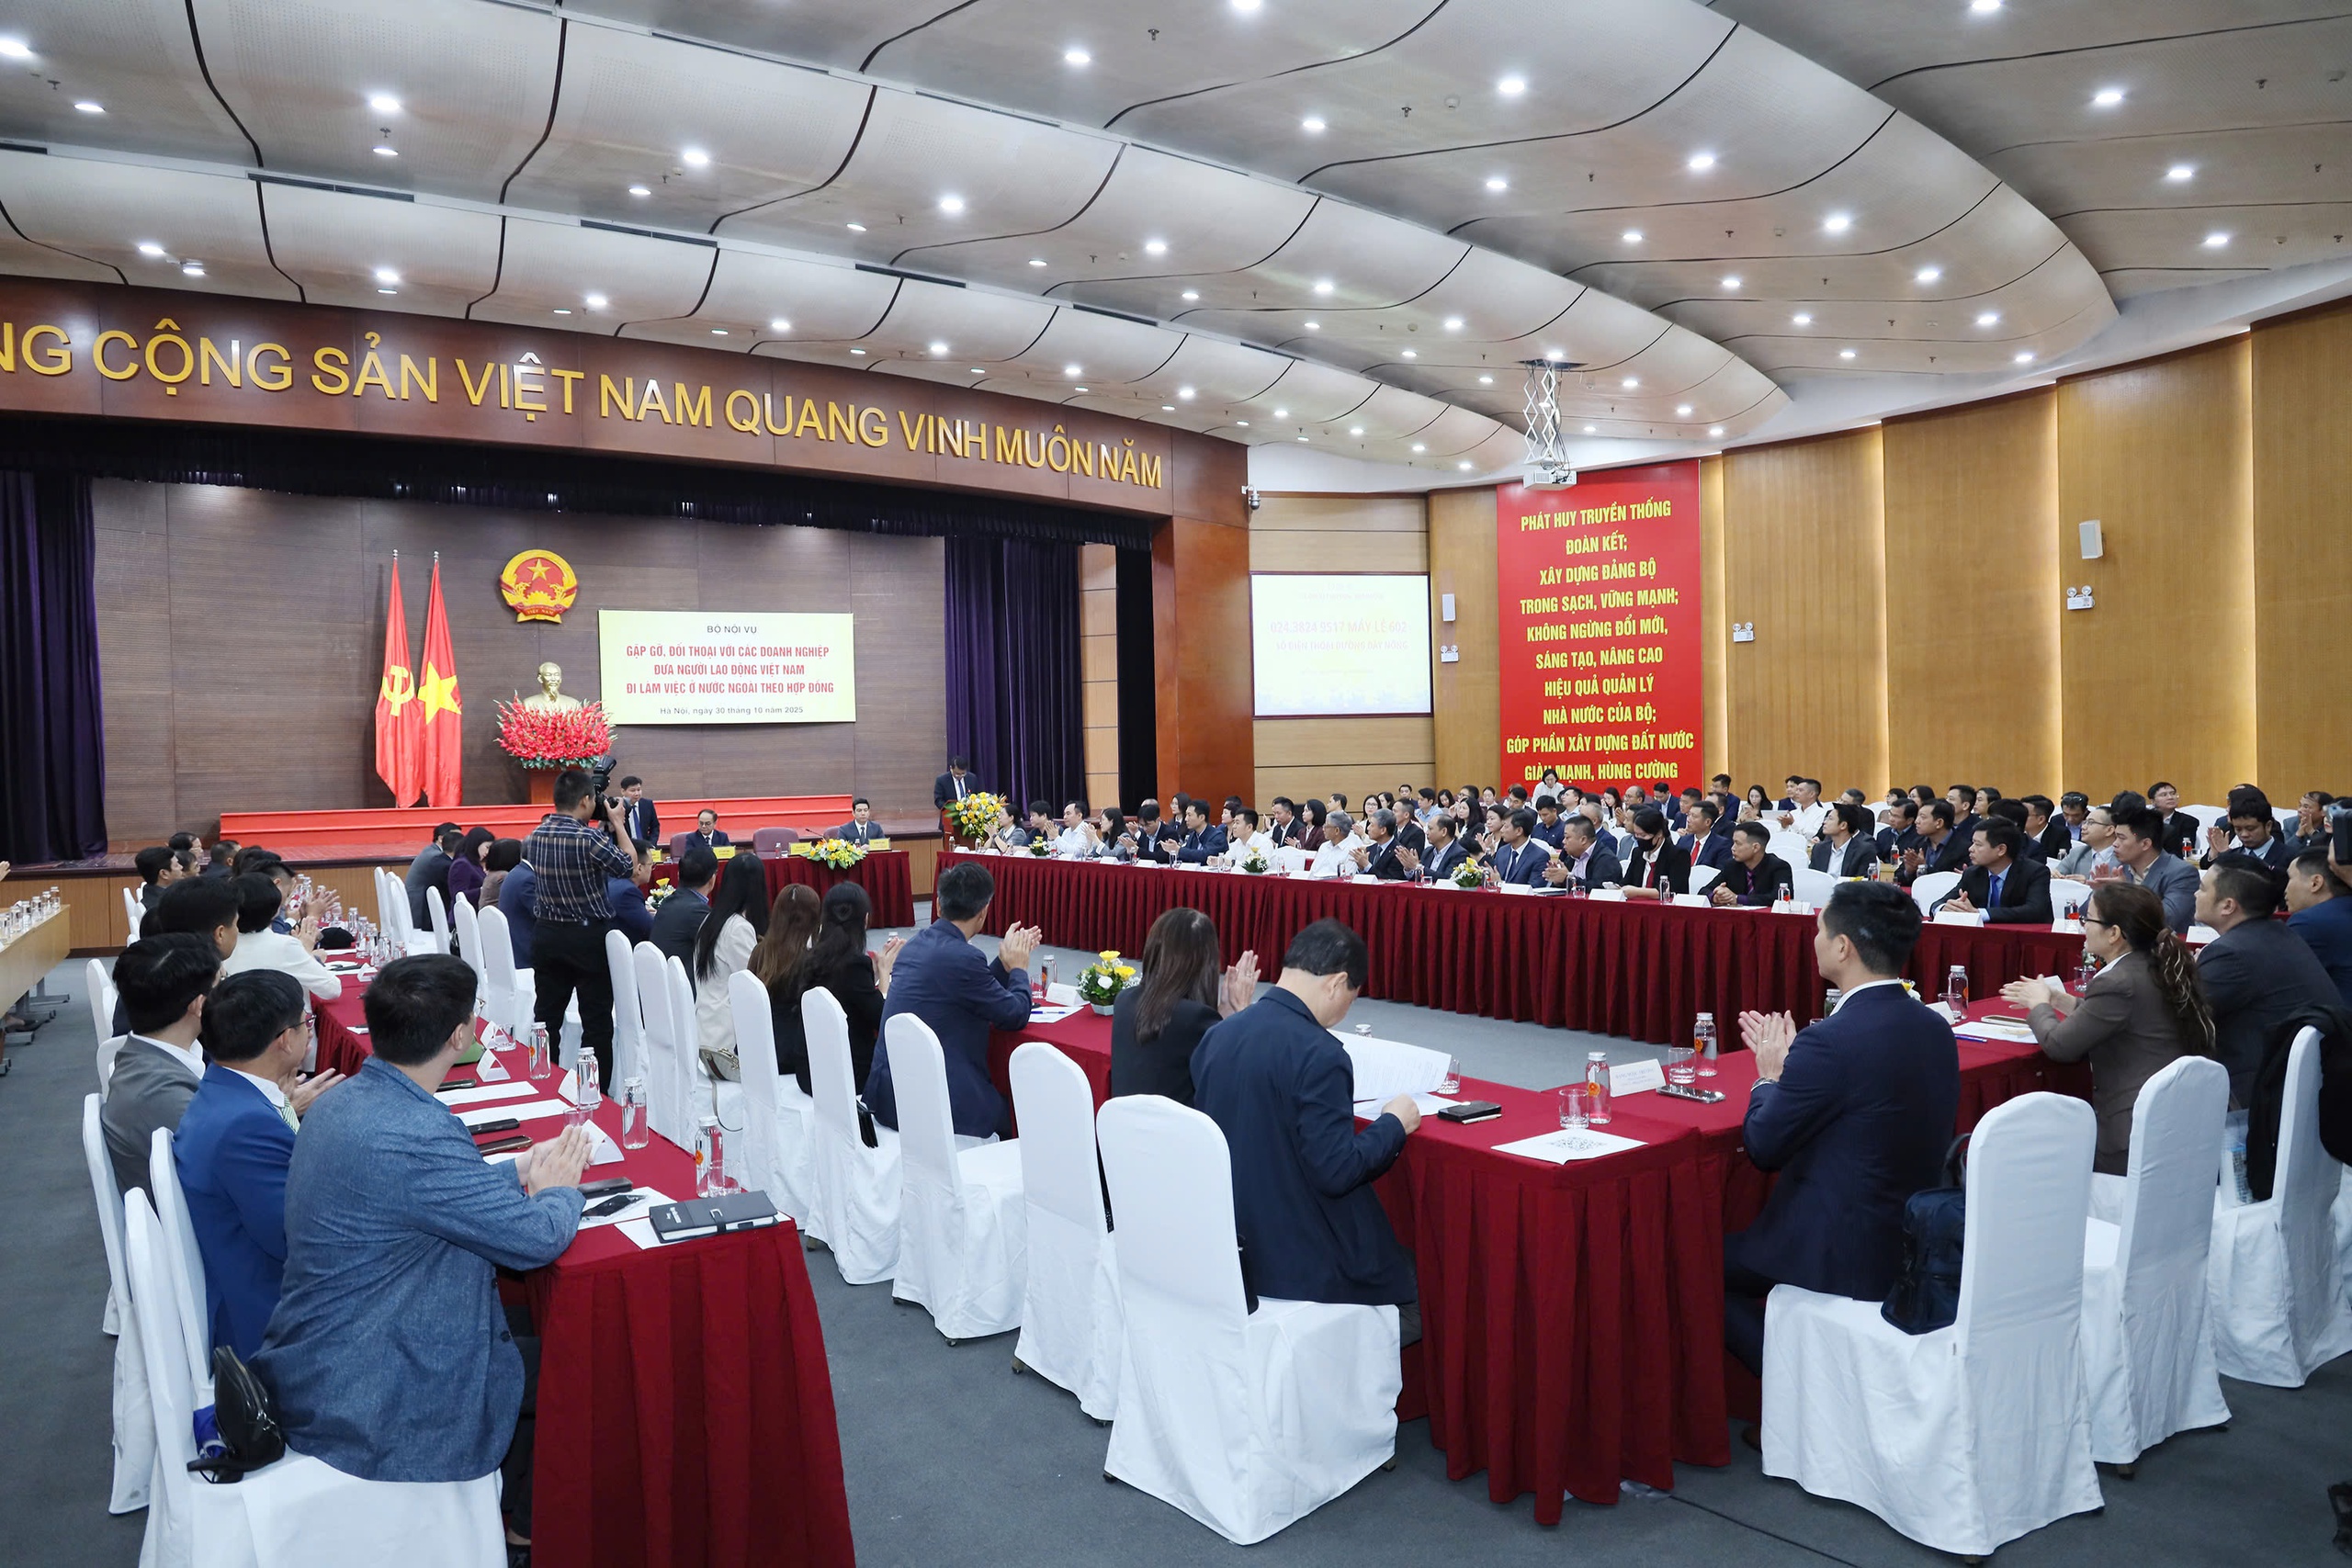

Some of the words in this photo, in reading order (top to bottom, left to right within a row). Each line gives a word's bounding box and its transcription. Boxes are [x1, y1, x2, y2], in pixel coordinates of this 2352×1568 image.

[93, 319, 292, 395] CỘNG
[311, 332, 438, 402] SẢN
[456, 352, 584, 422] VIỆT
[600, 375, 713, 428] NAM
[725, 389, 888, 448] QUANG
[899, 410, 987, 460] VINH
[995, 424, 1092, 478] MUÔN
[1098, 438, 1162, 489] NĂM
[1521, 511, 1552, 532] PHÁT
[1554, 510, 1577, 529] HUY
[1579, 501, 1627, 525] TRUYỀN
[1629, 496, 1672, 520] THỐNG
[1566, 535, 1600, 556] ĐOÀN
[1601, 529, 1629, 553] KẾT;
[1539, 566, 1563, 586] XÂY
[1565, 564, 1600, 587] DỰNG
[1601, 558, 1636, 581] ĐẢNG
[1639, 557, 1657, 581] BỘ
[1520, 596, 1559, 615] TRONG
[1561, 592, 1598, 615] SẠCH,
[1600, 589, 1634, 609] VỮNG
[1636, 587, 1679, 610] MẠNH;
[707, 624, 721, 635] BỘ
[724, 624, 741, 635] NỘI
[744, 626, 757, 636] VỤ
[1526, 621, 1567, 643] KHÔNG
[1569, 618, 1612, 640] NGỪNG
[1614, 613, 1636, 637] ĐỔI
[1639, 614, 1669, 637] MỚI,
[627, 644, 647, 660] GẶP
[650, 643, 666, 658] GỠ,
[669, 642, 685, 657] ĐỐI
[688, 646, 717, 660] THOẠI
[719, 644, 735, 657] VỚI
[738, 644, 757, 658] CÁC
[760, 646, 793, 658] DOANH
[795, 644, 830, 660] NGHIỆP
[1534, 648, 1568, 670] SÁNG
[1570, 650, 1598, 671] TẠO,
[1600, 646, 1635, 666] NÂNG
[1638, 646, 1664, 664] CAO
[653, 663, 674, 675] ĐƯA
[677, 661, 707, 675] NGƯỜI
[710, 664, 729, 675] LAO
[730, 662, 758, 677] ĐỘNG
[760, 662, 780, 677] VIỆT
[782, 664, 805, 675] NAM
[626, 682, 637, 694] ĐI
[639, 681, 662, 694] LÀM
[663, 681, 686, 696] VIỆC
[689, 679, 696, 694] Ở
[698, 681, 725, 694] NƯỚC
[728, 681, 758, 694] NGOÀI
[760, 682, 784, 694] THEO
[786, 682, 806, 695] HỢP
[808, 679, 834, 694] ĐỒNG
[1544, 677, 1573, 700] HIỆU
[1574, 673, 1600, 697] QUẢ
[1601, 671, 1636, 696] QUẢN
[1639, 672, 1655, 693] LÝ
[673, 707, 691, 716] Nội,
[693, 707, 713, 716] ngày
[715, 706, 726, 715] 30
[727, 706, 752, 716] tháng
[1543, 705, 1568, 725] NHÀ
[1570, 704, 1604, 725] NƯỚC
[1607, 700, 1634, 724] CỦA
[1635, 702, 1657, 726] BỘ;
[1506, 734, 1531, 754] GÓP
[1532, 731, 1566, 753] PHẦN
[1567, 733, 1592, 752] XÂY
[1594, 733, 1629, 755] DỰNG
[1631, 728, 1656, 751] ĐẤT
[1658, 729, 1695, 750] NƯỚC
[1524, 761, 1553, 782] GIÀ
[1555, 764, 1595, 784] MẠNH,
[1598, 760, 1632, 780] HÙNG
[1634, 758, 1679, 780] CƯỜNG
